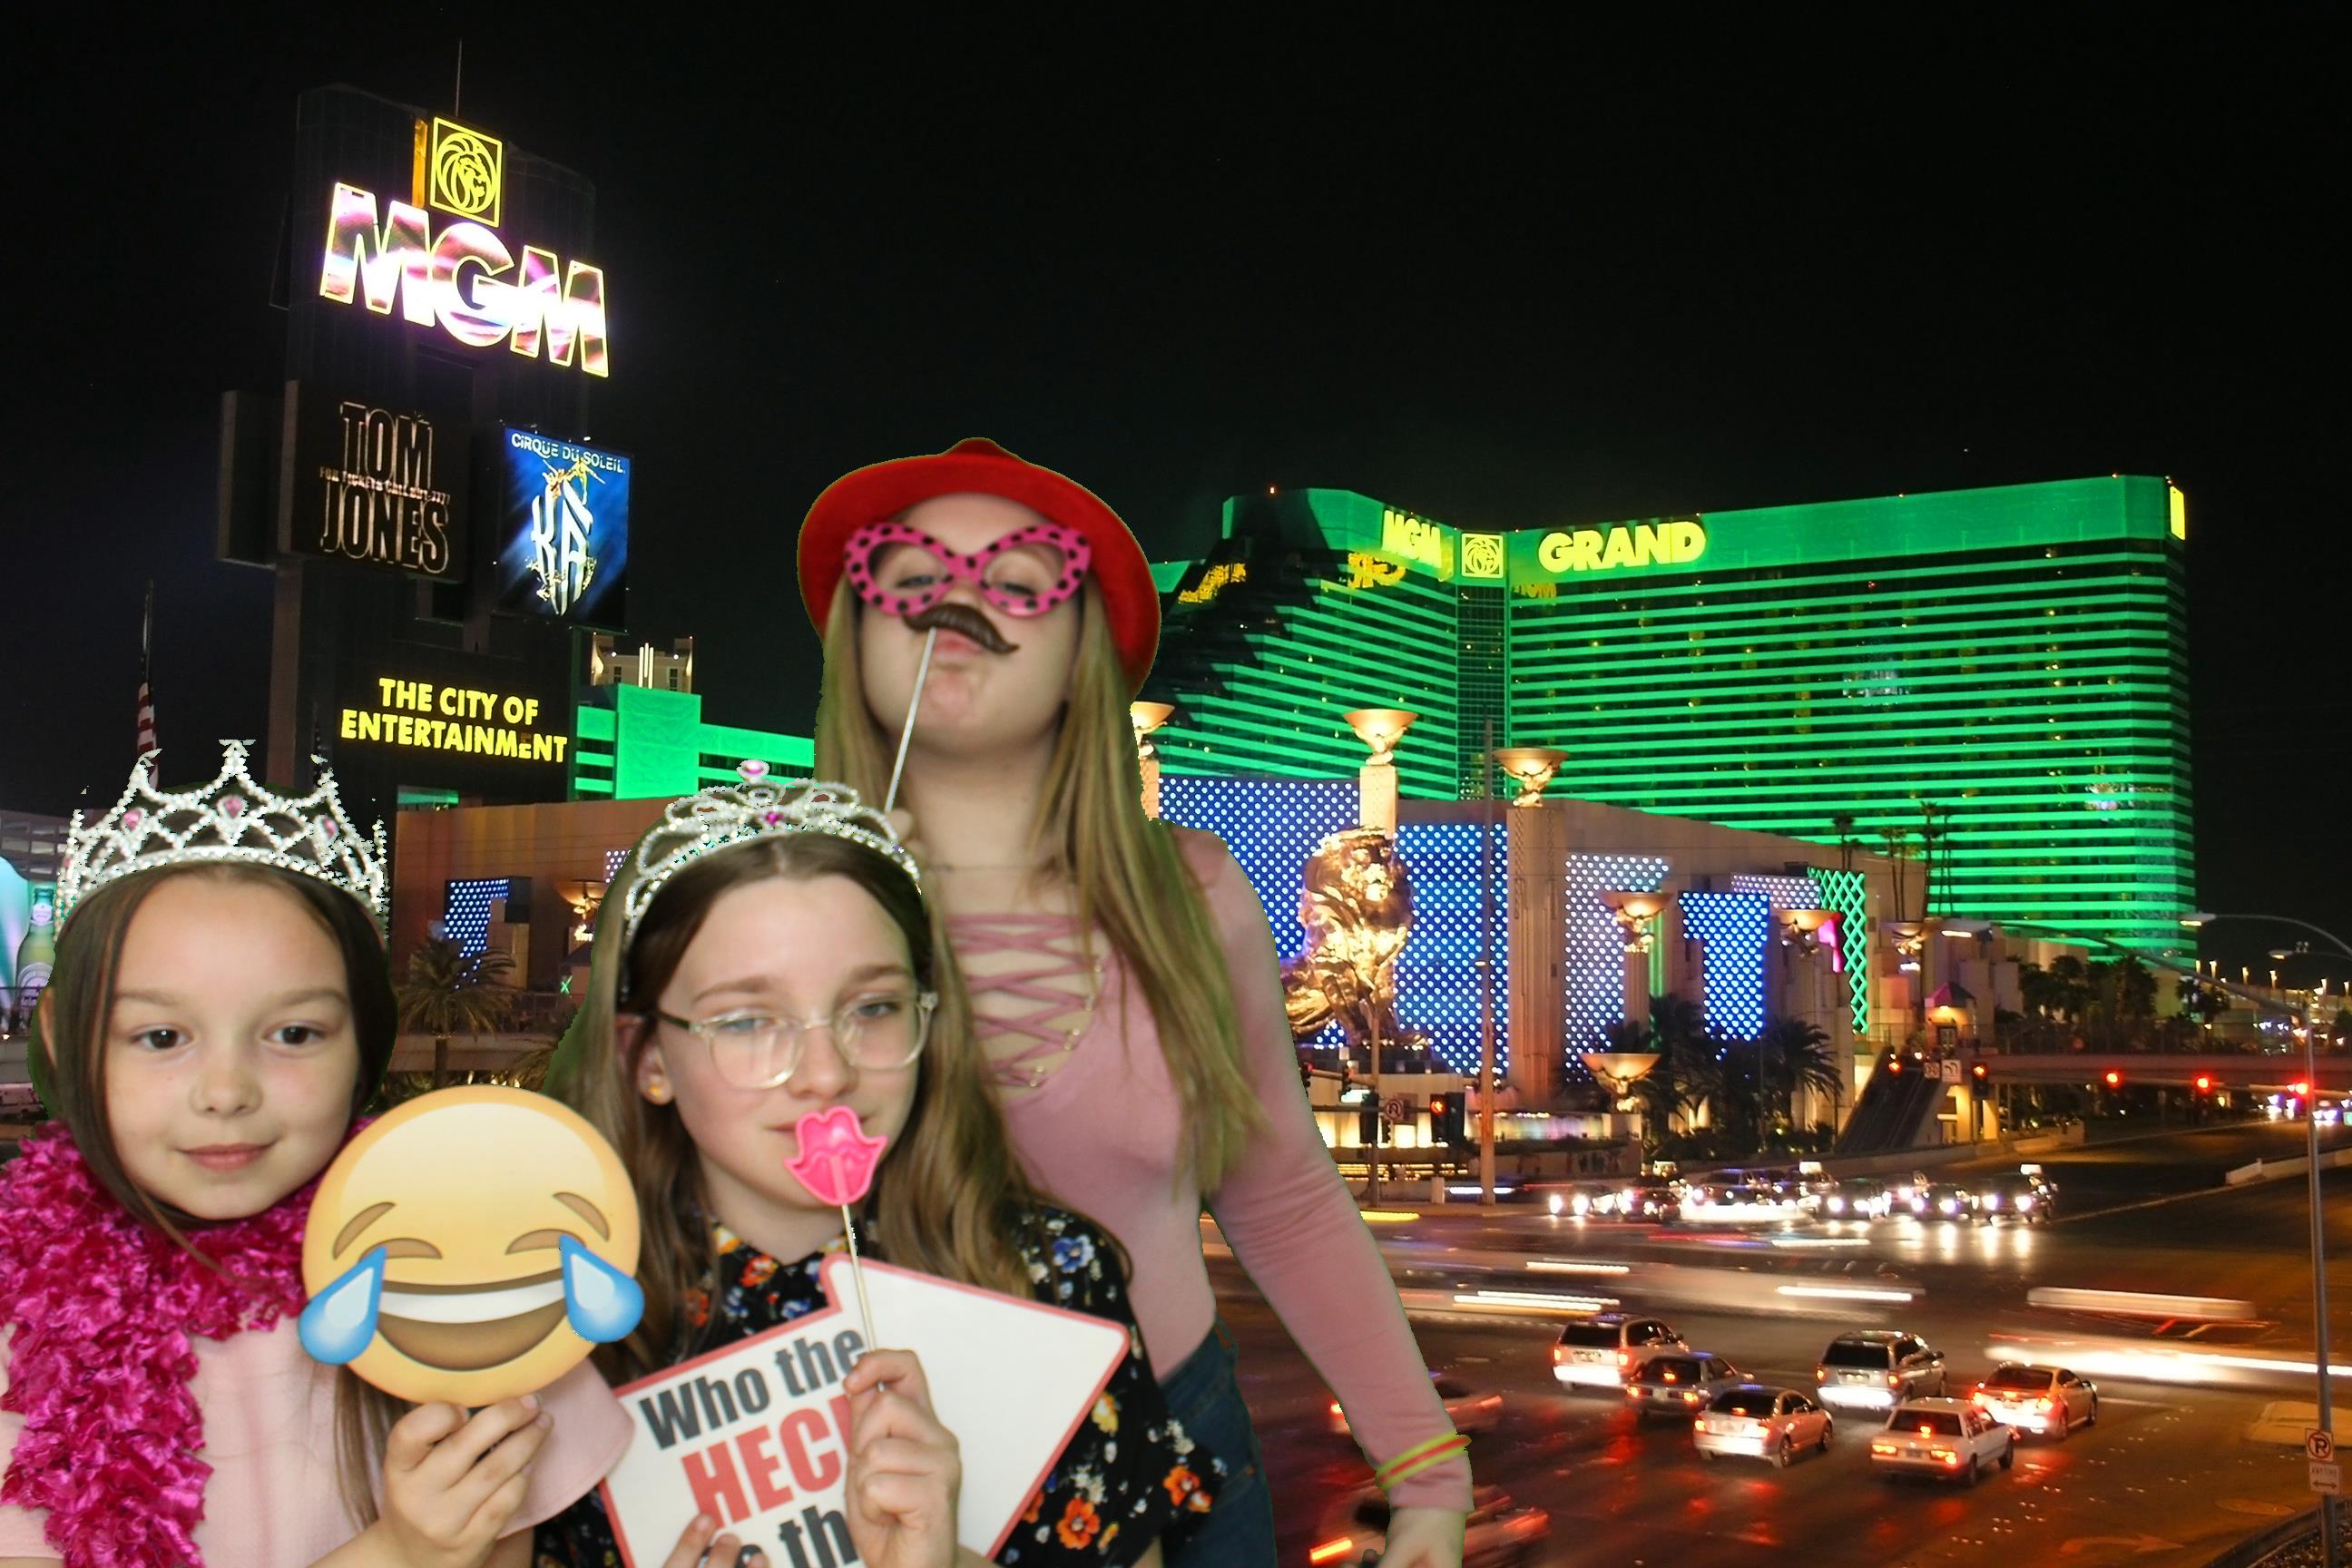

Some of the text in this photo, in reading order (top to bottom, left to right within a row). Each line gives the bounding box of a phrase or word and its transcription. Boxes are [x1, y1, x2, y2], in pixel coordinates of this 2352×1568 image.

[319, 181, 609, 377] MGM
[339, 401, 433, 490] TOM
[511, 433, 624, 474] CIRQUE DU SOLEIL
[320, 479, 449, 573] JONES
[1381, 509, 1706, 573] MGM GRAND
[378, 677, 539, 726] THE CITY OF
[340, 709, 568, 763] ENTERTAINMENT
[639, 1329, 866, 1451] Who the
[779, 1505, 860, 1568] th
